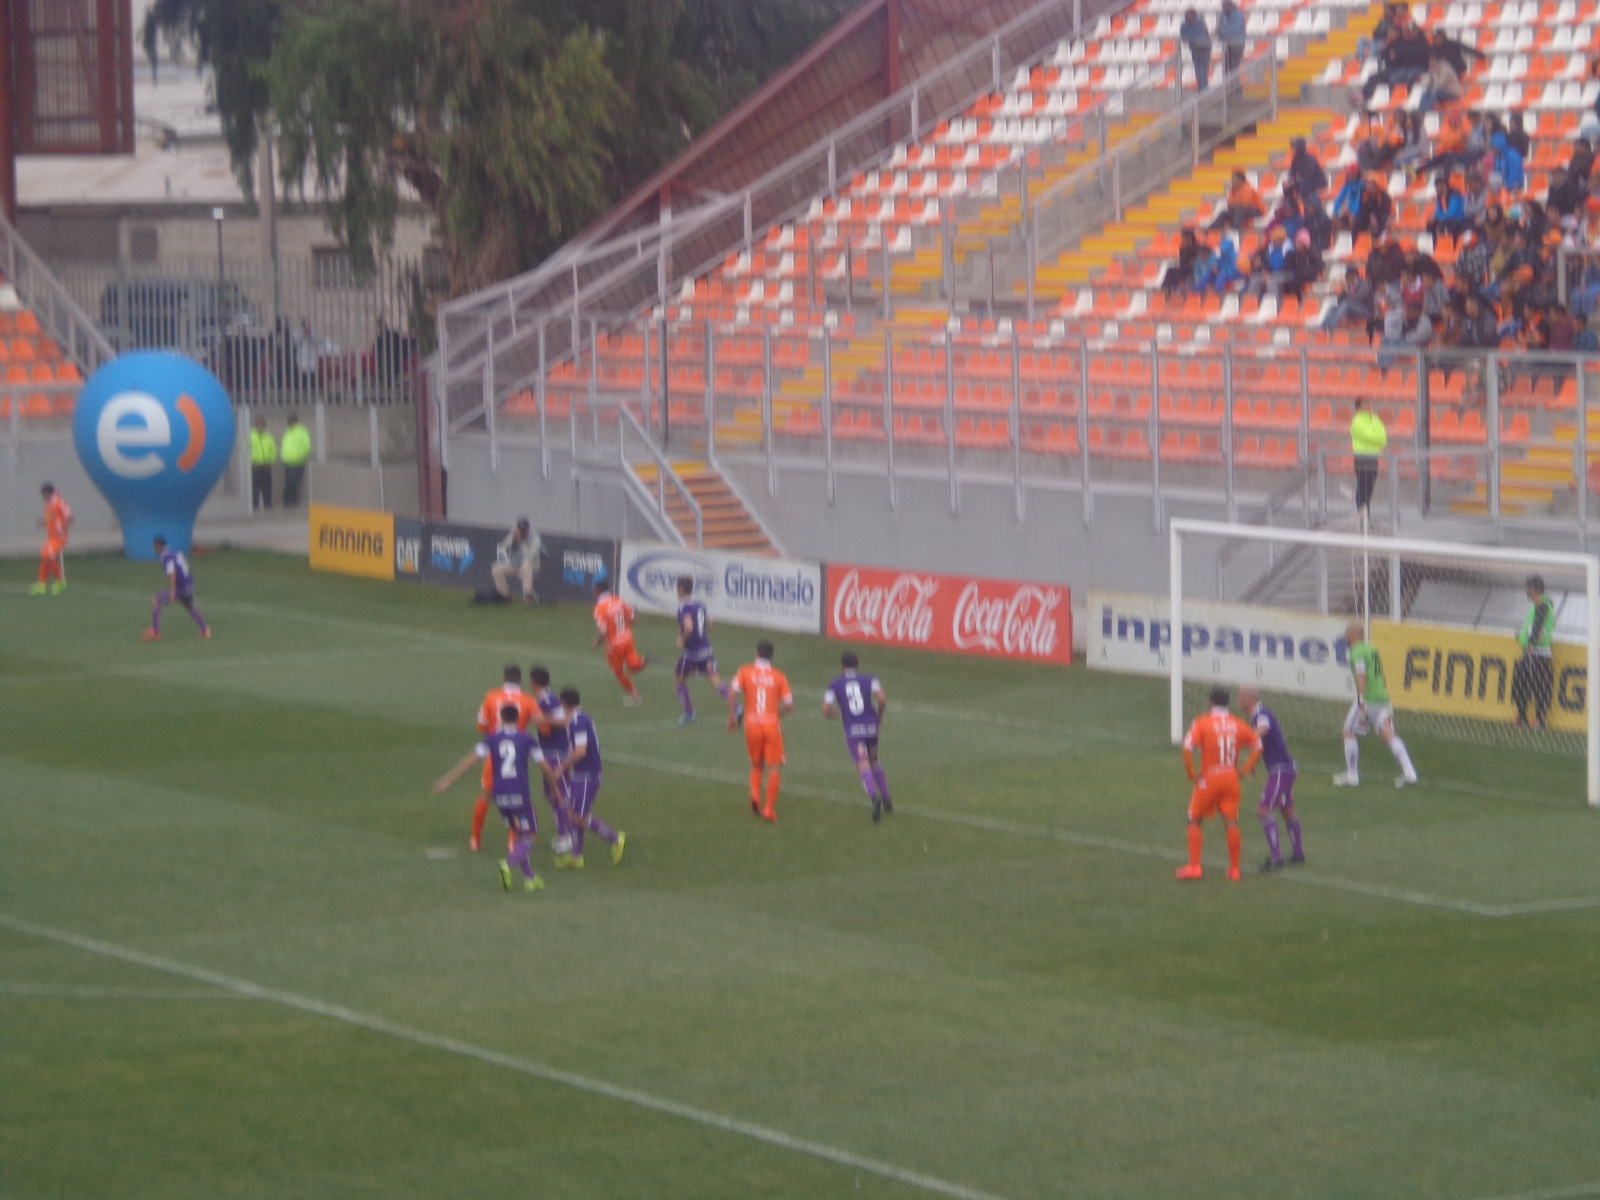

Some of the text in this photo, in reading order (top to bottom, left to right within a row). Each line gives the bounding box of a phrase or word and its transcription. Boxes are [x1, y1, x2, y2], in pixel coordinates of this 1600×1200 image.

[396, 535, 420, 574] CAT
[725, 560, 815, 606] Gimnasio
[1403, 646, 1588, 713] FINNG
[498, 739, 518, 780] 2
